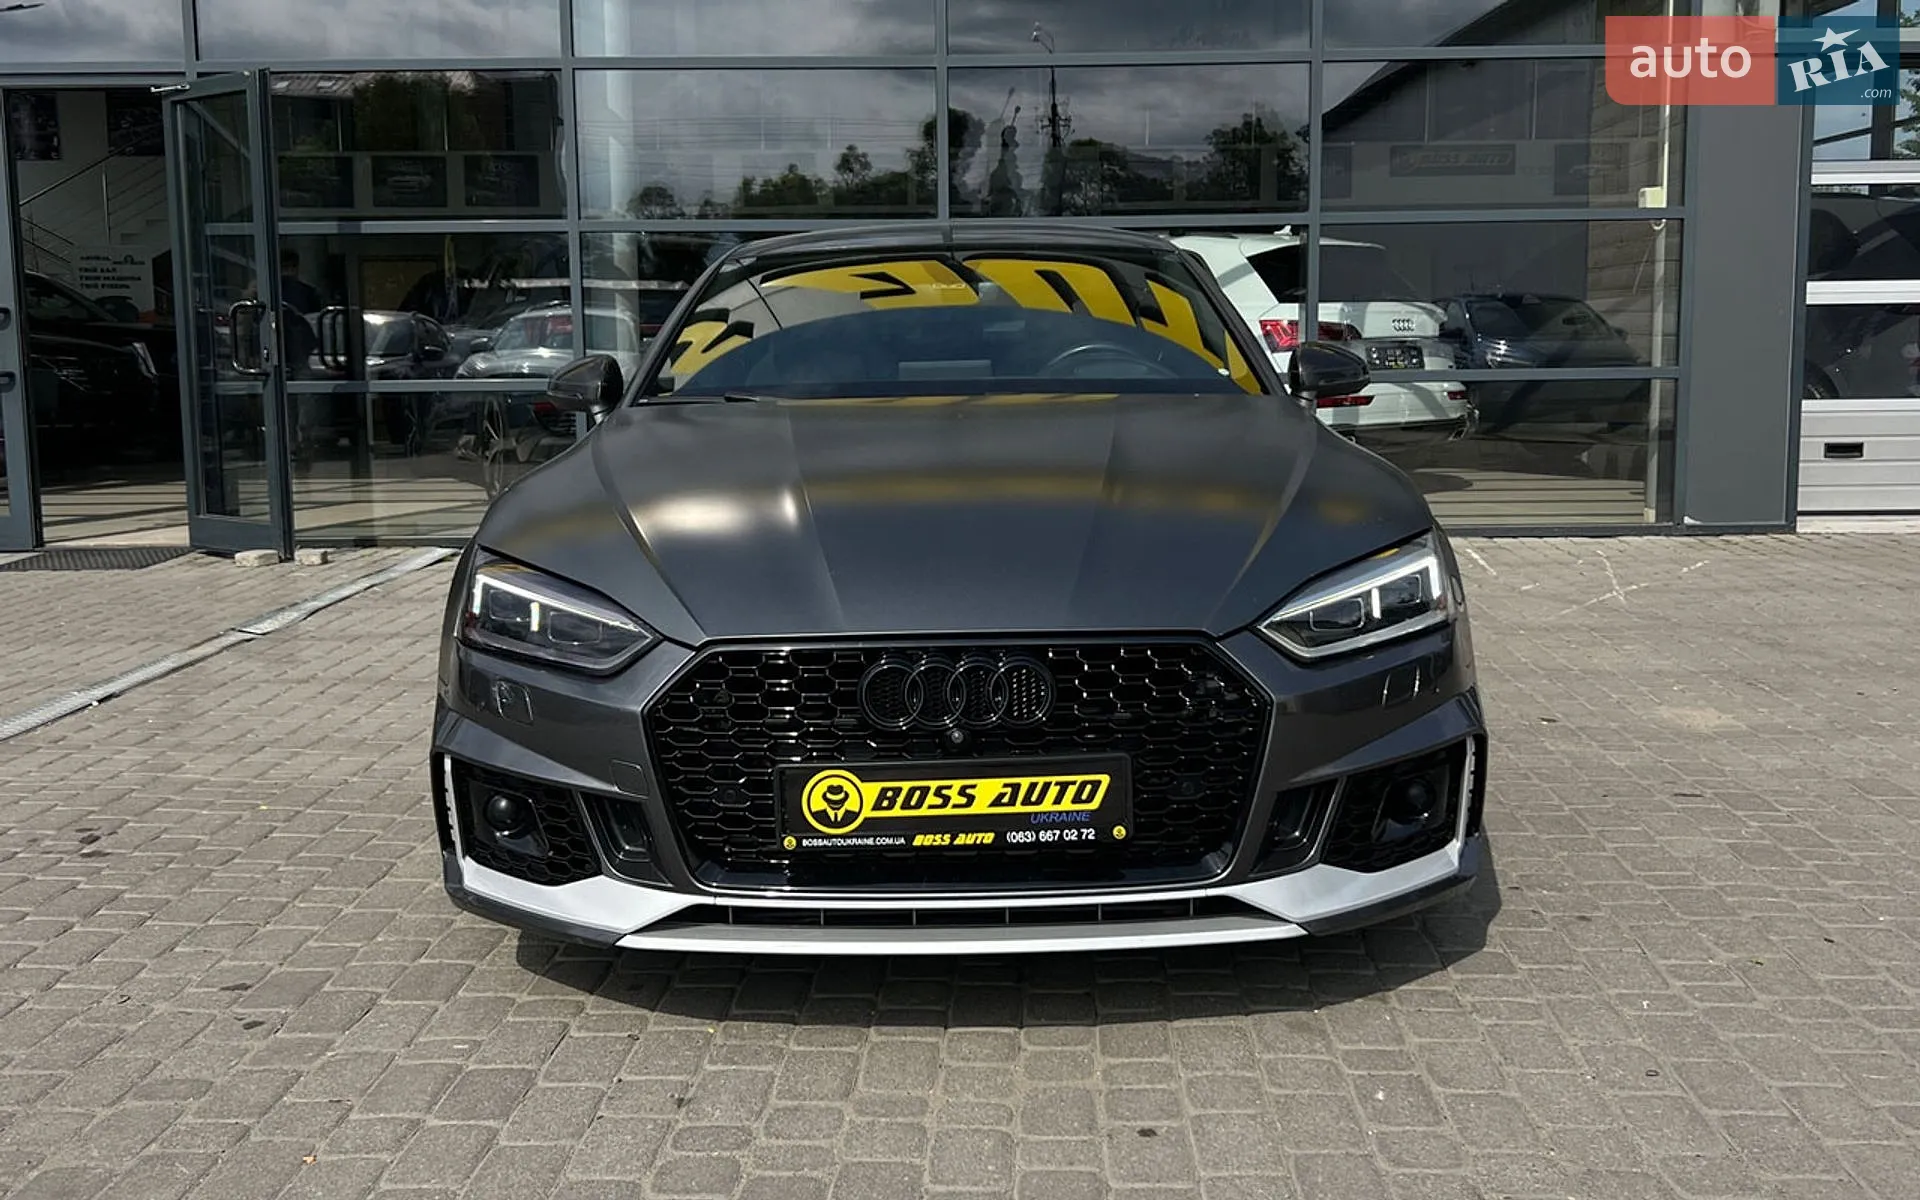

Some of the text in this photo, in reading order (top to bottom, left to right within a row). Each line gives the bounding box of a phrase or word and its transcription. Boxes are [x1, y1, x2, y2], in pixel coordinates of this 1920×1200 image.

[872, 779, 1103, 811] BOSS AUTO
[1031, 811, 1091, 824] UKRAINE
[912, 832, 995, 846] BOSS AUTO
[1039, 829, 1059, 842] 667
[1063, 829, 1078, 841] 02
[1081, 828, 1095, 840] 72
